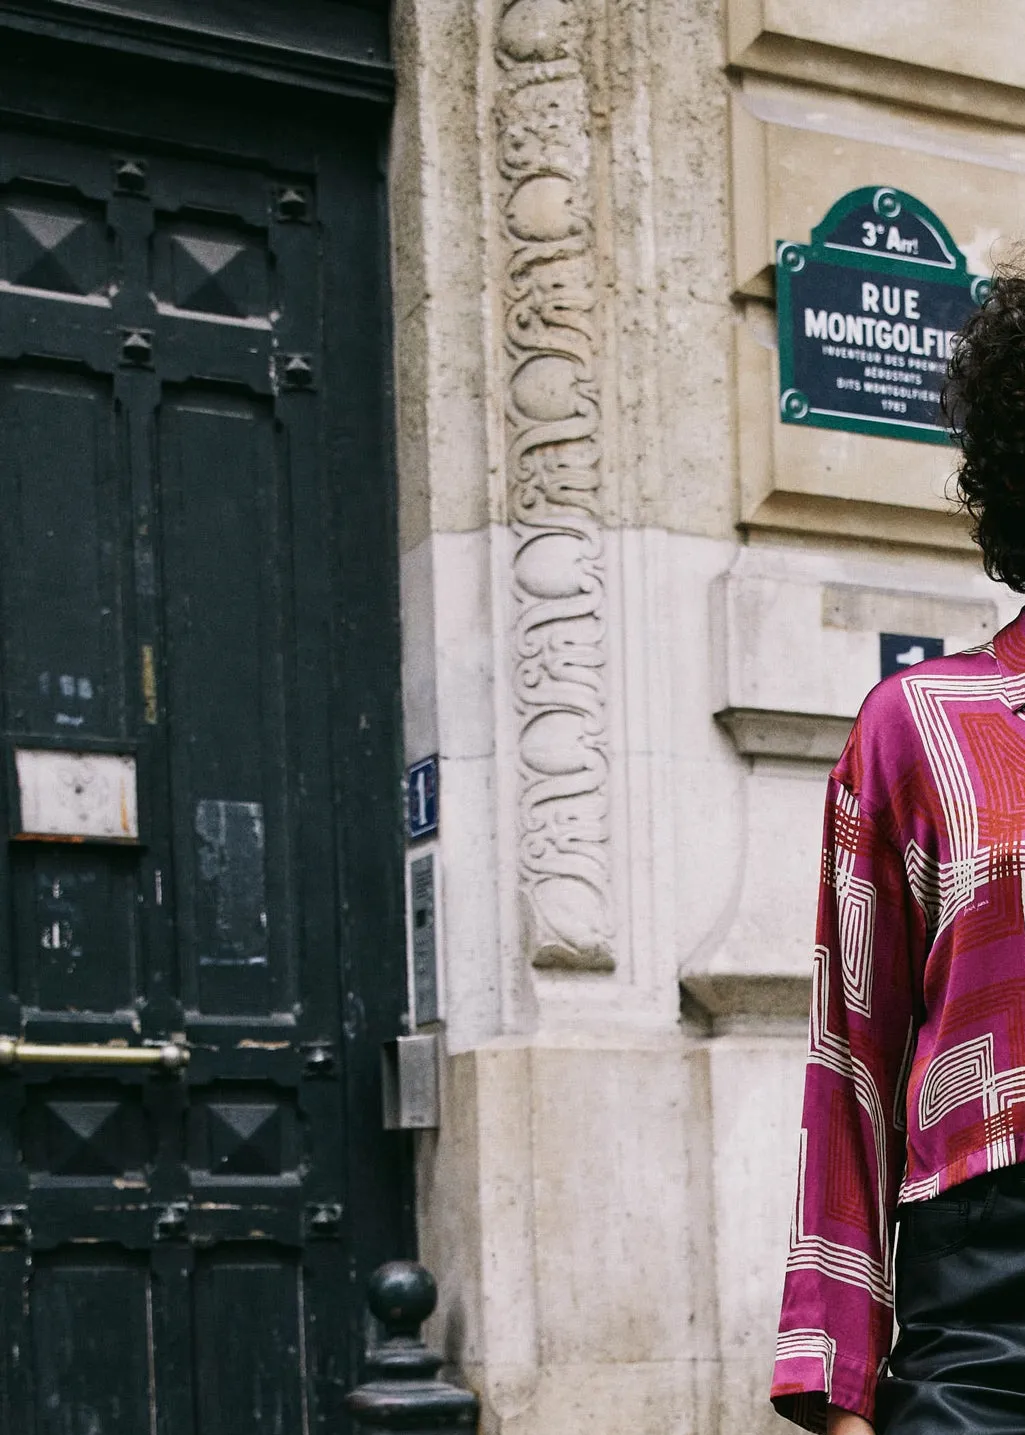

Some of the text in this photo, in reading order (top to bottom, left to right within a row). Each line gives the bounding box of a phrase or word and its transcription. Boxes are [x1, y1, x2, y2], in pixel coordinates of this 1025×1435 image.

[862, 281, 921, 321] RUE
[804, 307, 962, 361] MONTGOLFIE
[416, 771, 428, 826] 1
